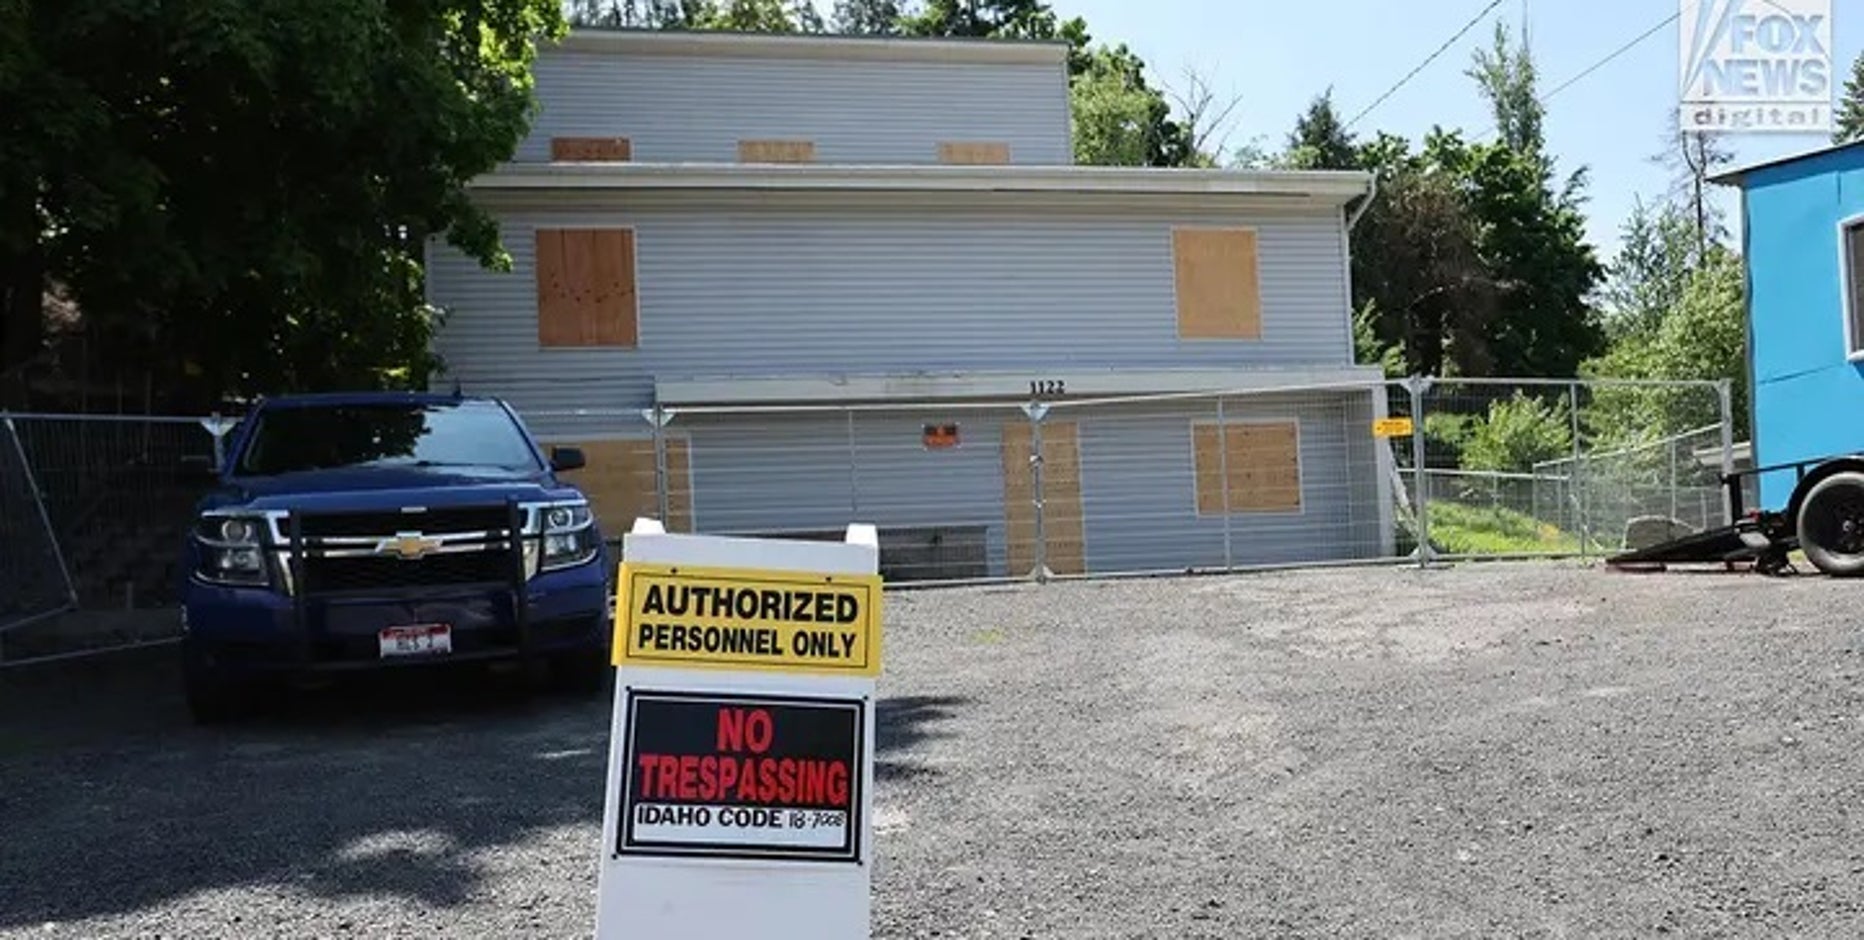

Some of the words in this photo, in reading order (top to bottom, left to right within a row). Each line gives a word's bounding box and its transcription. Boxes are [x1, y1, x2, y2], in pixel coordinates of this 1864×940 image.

[1030, 380, 1066, 395] 1122
[642, 585, 858, 623] AUTHORIZED
[638, 623, 783, 655] PERSONNEL
[793, 631, 857, 659] ONLY
[717, 708, 773, 752] NO
[639, 754, 848, 805] TRESPASSING
[637, 805, 710, 827] IDAHO
[718, 808, 783, 828] CODE
